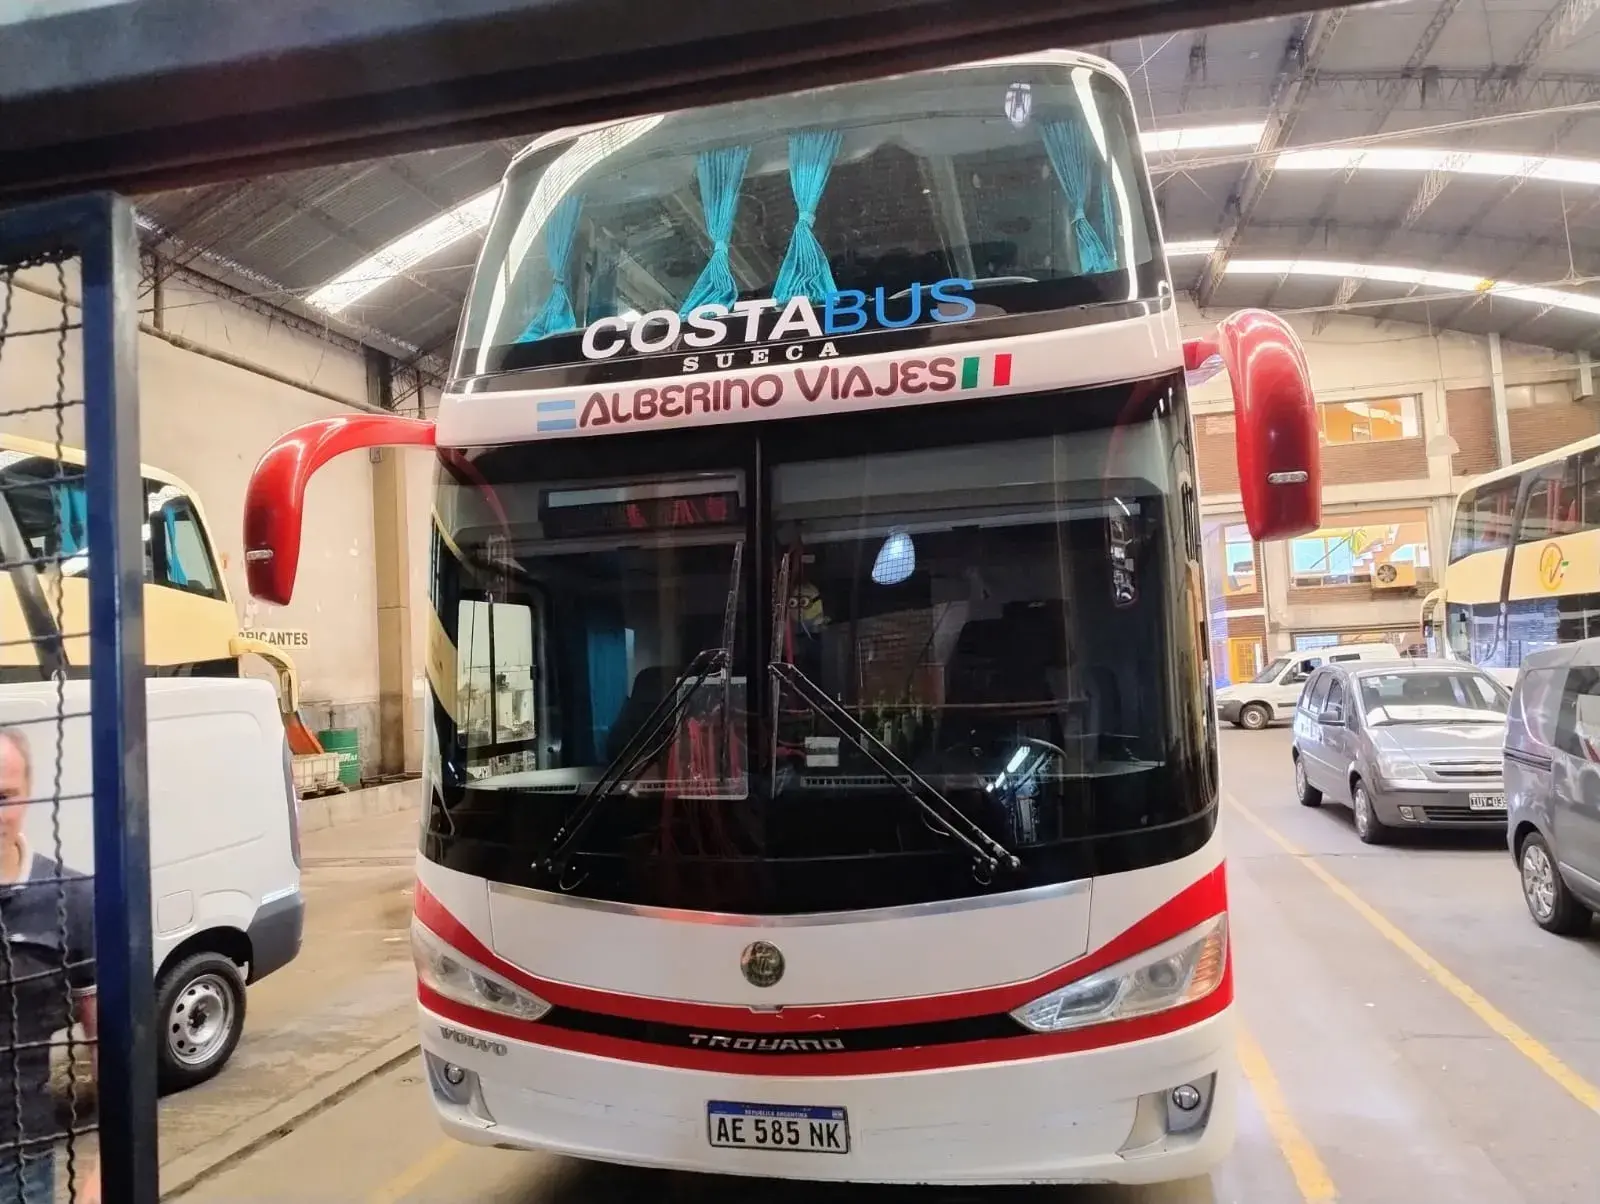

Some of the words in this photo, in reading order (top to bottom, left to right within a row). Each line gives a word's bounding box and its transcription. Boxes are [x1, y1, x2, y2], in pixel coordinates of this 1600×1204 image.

[683, 342, 839, 372] SUECA
[794, 357, 956, 402] VIAJES
[438, 1025, 507, 1056] VOLVO
[689, 1034, 845, 1050] TROYANO
[717, 1117, 746, 1143] AE
[754, 1119, 800, 1145] 585
[809, 1122, 840, 1148] NK
